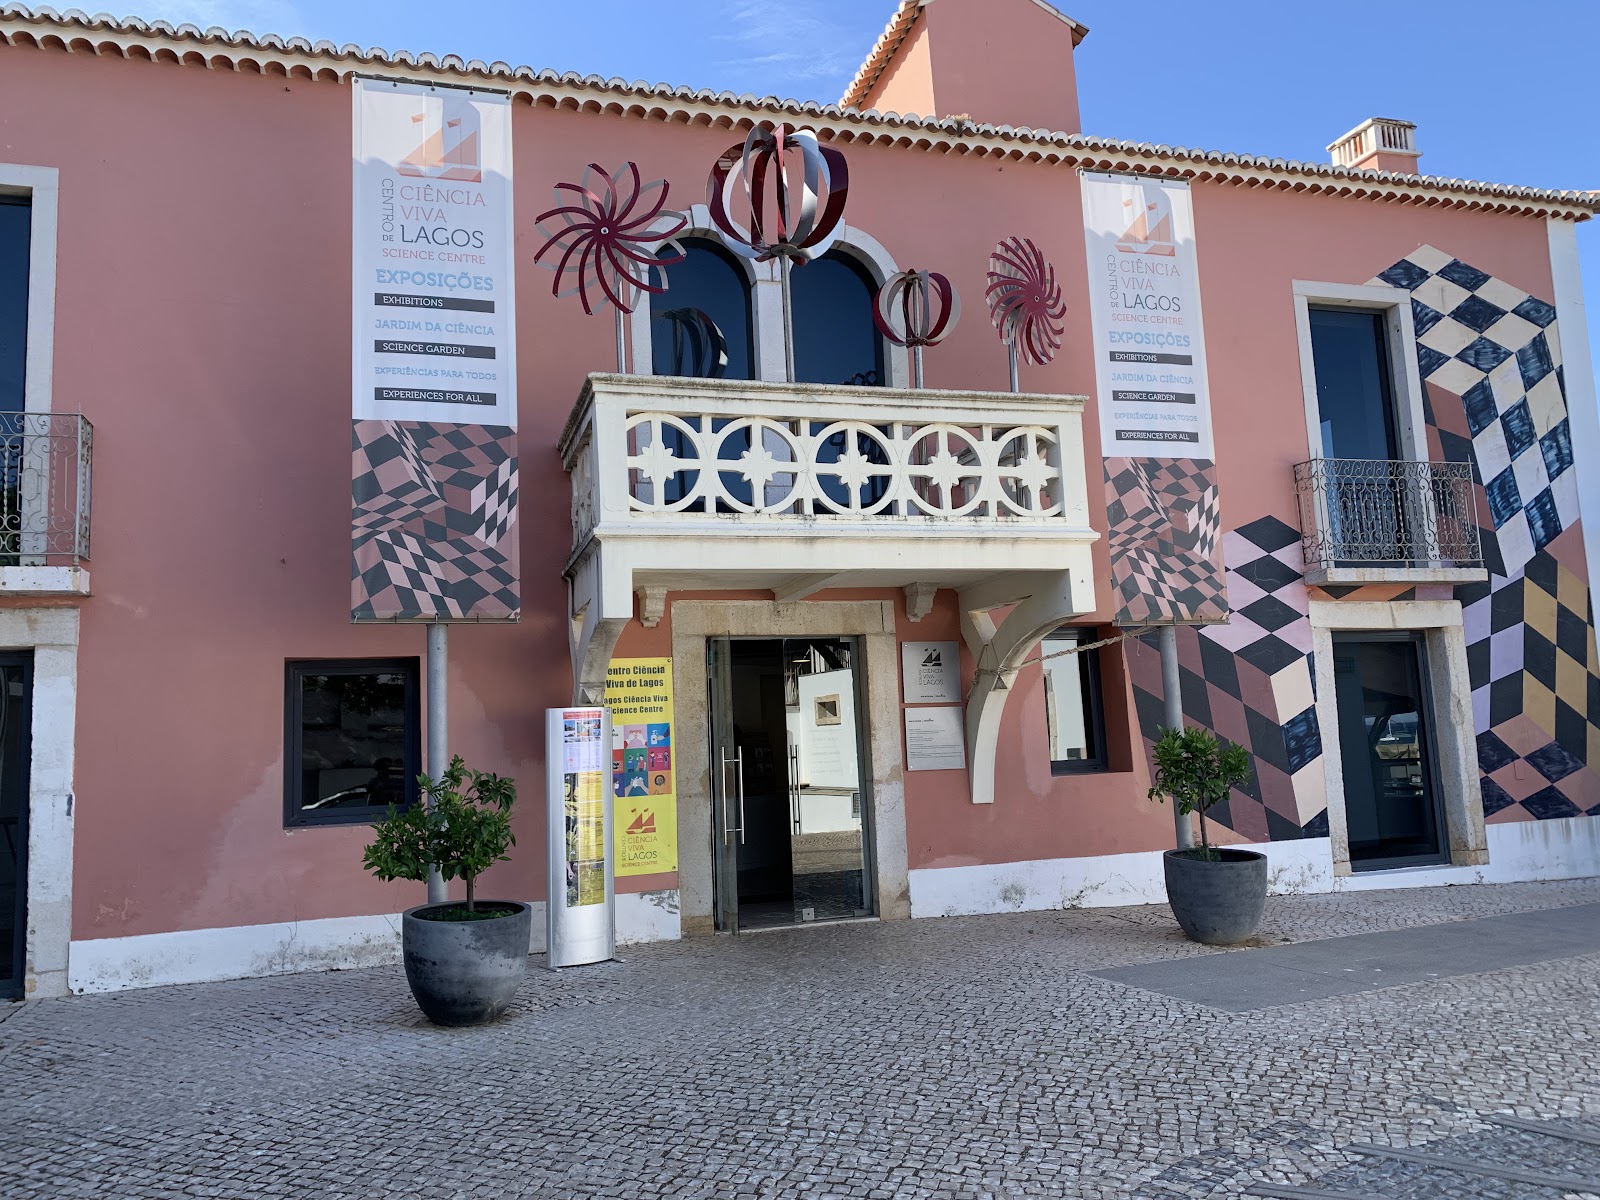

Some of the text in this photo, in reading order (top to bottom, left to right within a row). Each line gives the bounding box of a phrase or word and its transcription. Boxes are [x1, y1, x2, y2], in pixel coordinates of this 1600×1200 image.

[400, 184, 486, 207] CIÊNCIA
[382, 178, 394, 232] CENTRO
[400, 205, 447, 223] VIVA
[382, 234, 394, 242] DE
[400, 224, 484, 249] LAGOS
[382, 247, 486, 265] SCIENCE CENTRE
[1120, 258, 1181, 277] CIÊNCIA
[375, 268, 494, 291] EXPOSIÇÕES
[1106, 254, 1119, 300] CENTRO
[1121, 277, 1155, 291] VIVA
[382, 295, 444, 307] EXHIBITIONS
[1122, 292, 1181, 312] LAGOS
[1111, 313, 1184, 326] SCIENCE CENTRE
[374, 319, 495, 336] JARDIM DA CIÊNCIA
[1108, 331, 1191, 348] EXPOSIÇÕES
[382, 342, 466, 355] SCIENCE GARDEN
[1115, 353, 1157, 362] EXHIBITIONS
[374, 366, 497, 381] EXPERIÊNCIAS PARA TODOS
[1111, 373, 1194, 385] JARDIM DA CIÊNCIA
[382, 389, 483, 403] EXPERIENCES FOR ALL
[1118, 392, 1176, 401] SCIENCE GARDEN
[1114, 412, 1198, 422] EXPERIÊNCIAS PARA TODOS
[607, 665, 665, 675] entro Ciência
[606, 679, 664, 688] Viva de Lagos
[623, 695, 651, 704] Ciência
[653, 694, 668, 702] Viva
[612, 705, 664, 714] cience Centre
[628, 836, 658, 844] CIÊNCIA
[628, 850, 658, 860] LAGOS
